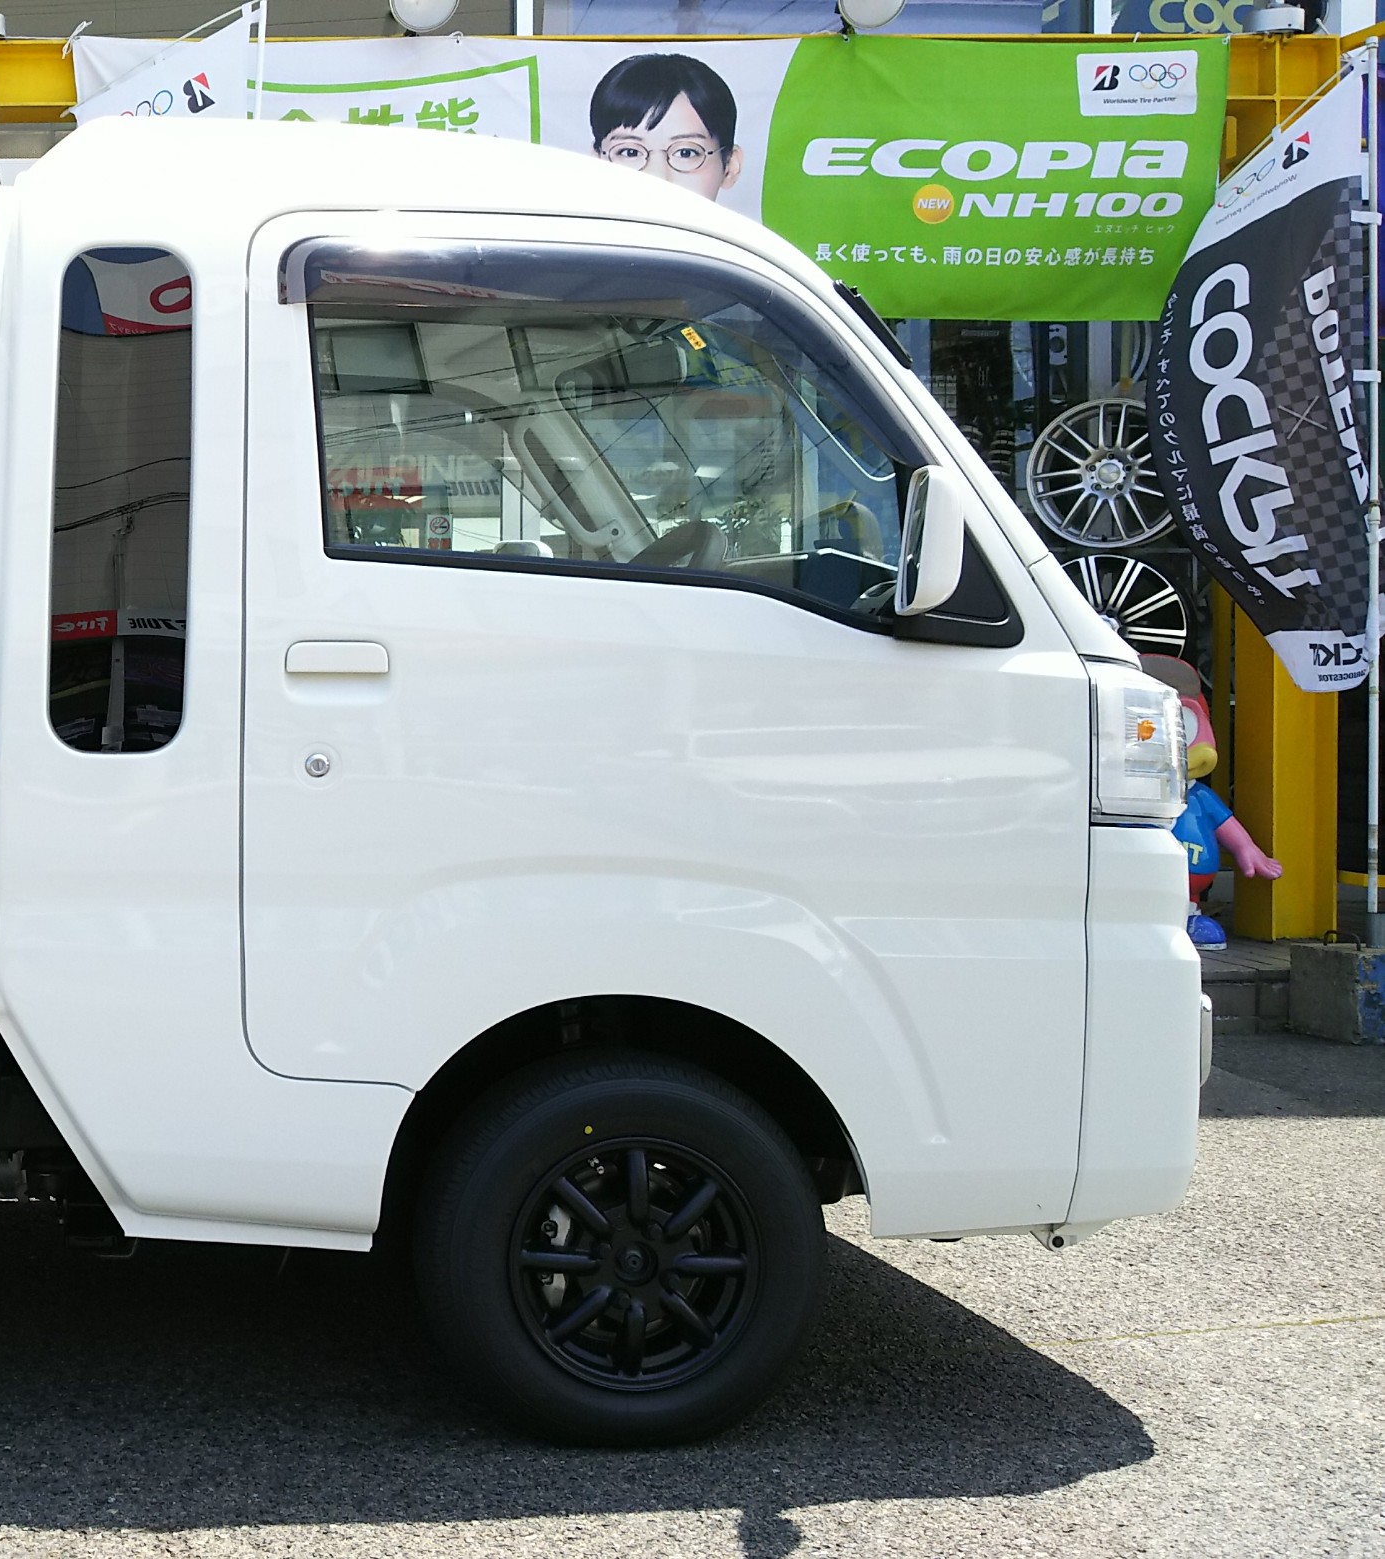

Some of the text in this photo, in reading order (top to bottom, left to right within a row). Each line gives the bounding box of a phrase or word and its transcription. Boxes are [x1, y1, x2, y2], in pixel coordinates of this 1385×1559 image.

[917, 198, 951, 210] NEW
[959, 192, 1184, 218] NH100
[815, 243, 1155, 267] 長く使っても、雨の日の安心感が長持ち
